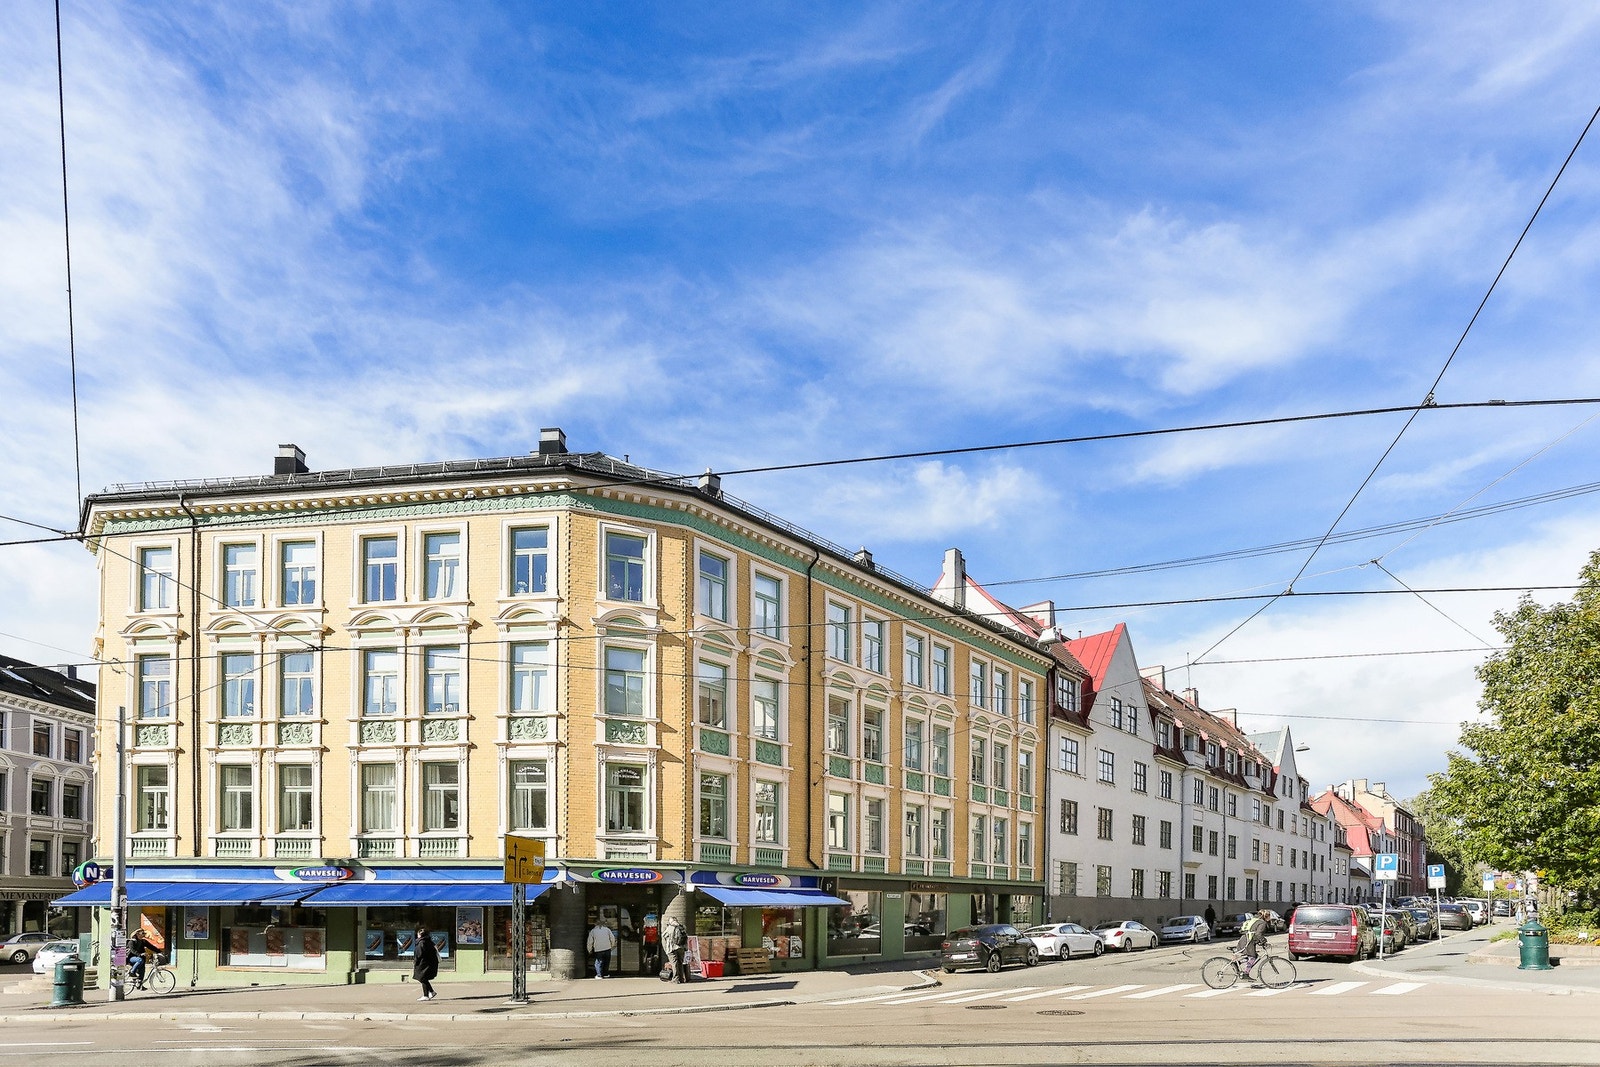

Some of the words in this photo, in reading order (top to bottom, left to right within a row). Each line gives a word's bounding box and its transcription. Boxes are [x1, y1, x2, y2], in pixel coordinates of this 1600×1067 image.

[1381, 856, 1392, 869] P
[86, 867, 97, 878] N
[603, 871, 652, 879] NARVESEN
[1432, 867, 1440, 876] P
[742, 876, 775, 884] NARVESEN
